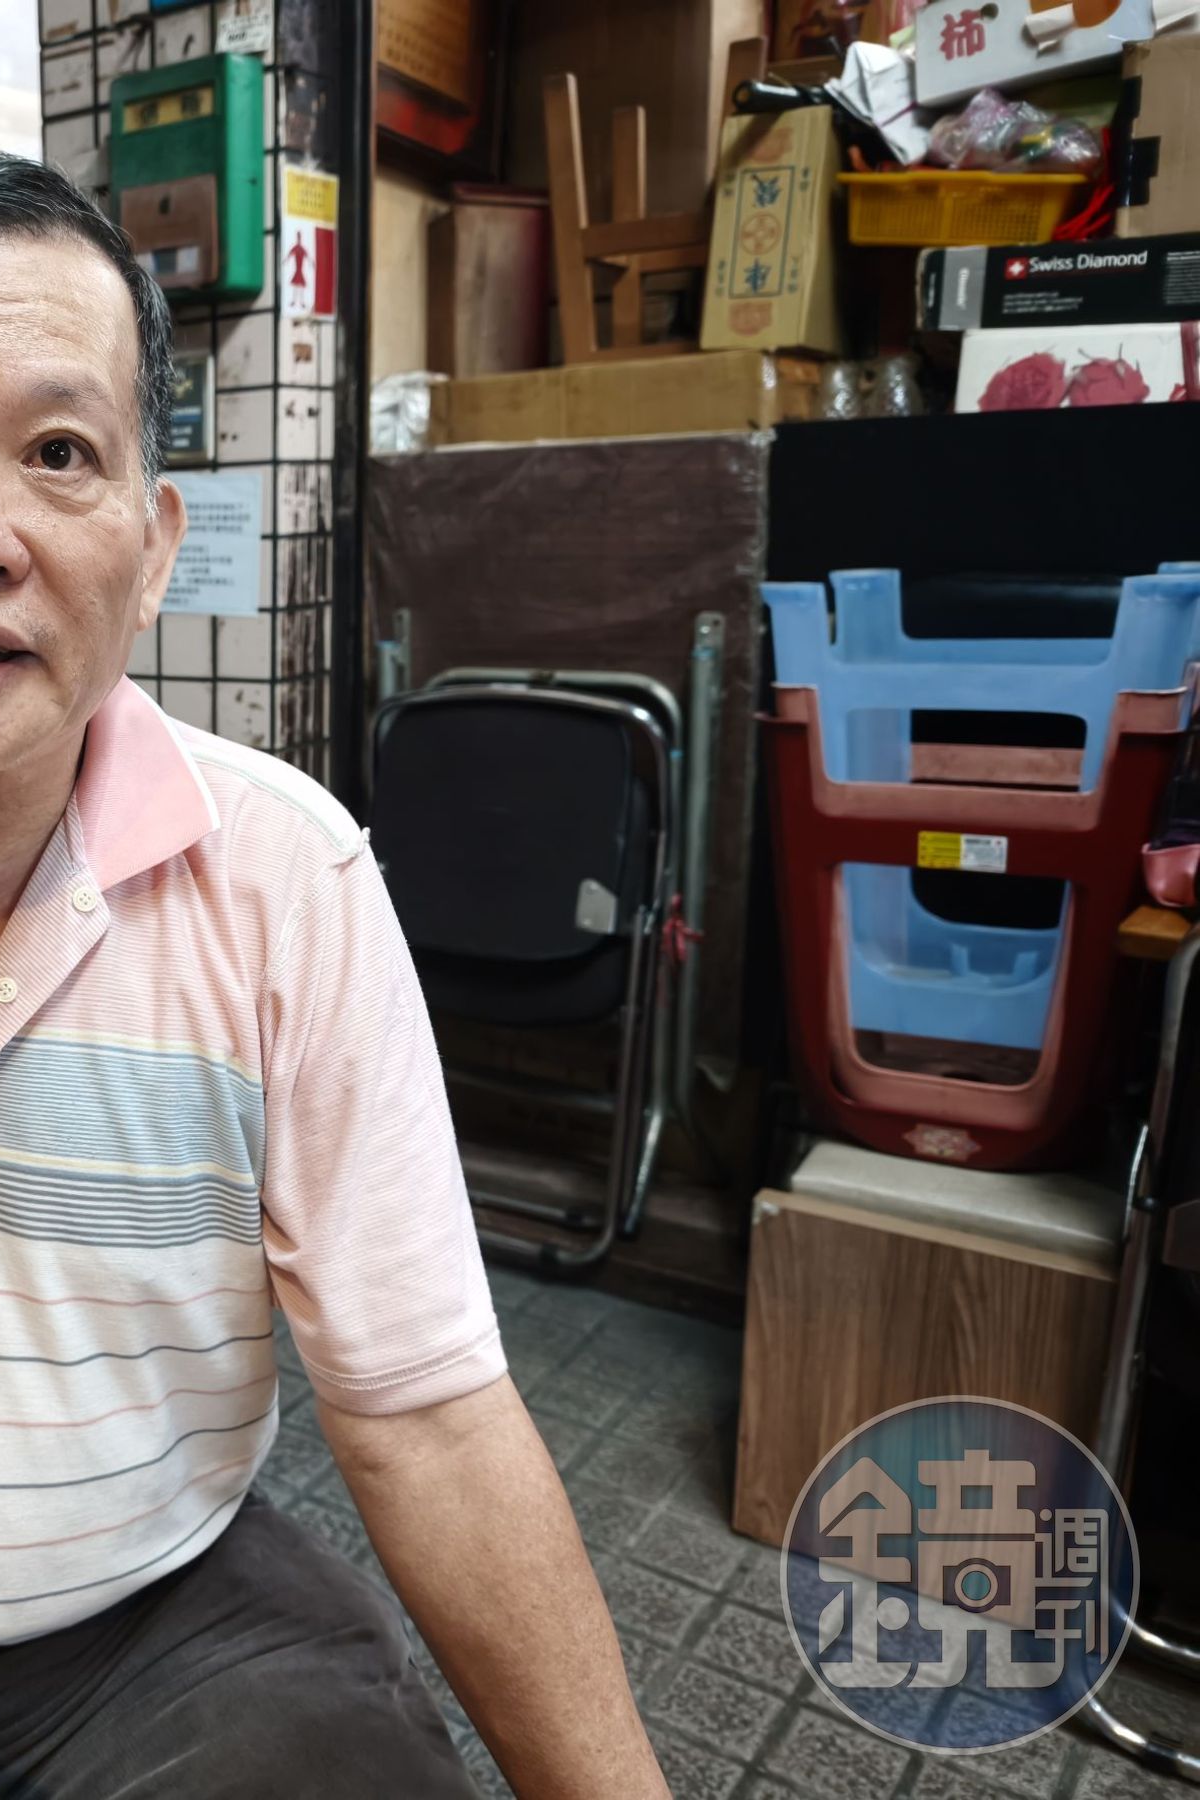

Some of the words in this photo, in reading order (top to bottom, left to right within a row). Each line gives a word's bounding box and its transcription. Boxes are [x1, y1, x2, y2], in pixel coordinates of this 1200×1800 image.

[940, 9, 986, 61] 柿
[1029, 256, 1074, 273] Swiss
[1077, 250, 1148, 269] Diamond
